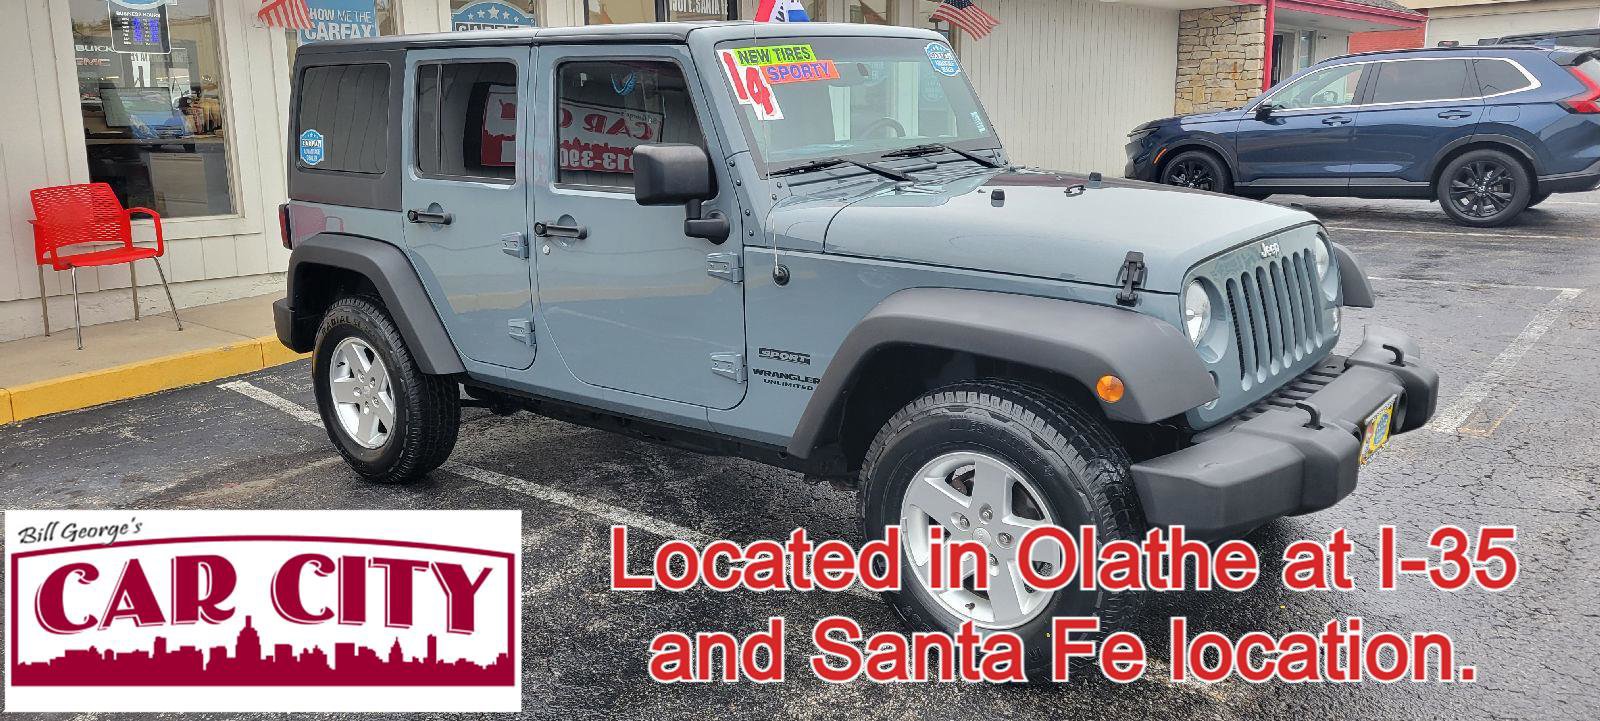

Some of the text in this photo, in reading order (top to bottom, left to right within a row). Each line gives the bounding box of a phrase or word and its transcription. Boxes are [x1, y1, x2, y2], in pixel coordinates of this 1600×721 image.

[307, 8, 372, 24] HOW ME THE
[304, 22, 372, 41] CARFAX
[737, 46, 812, 65] NEW TIRES
[766, 62, 832, 81] SPORTY
[1260, 241, 1280, 259] Jeep
[760, 348, 810, 364] SPORT
[752, 368, 821, 385] WRANGLER
[763, 379, 814, 391] UNLIMITED
